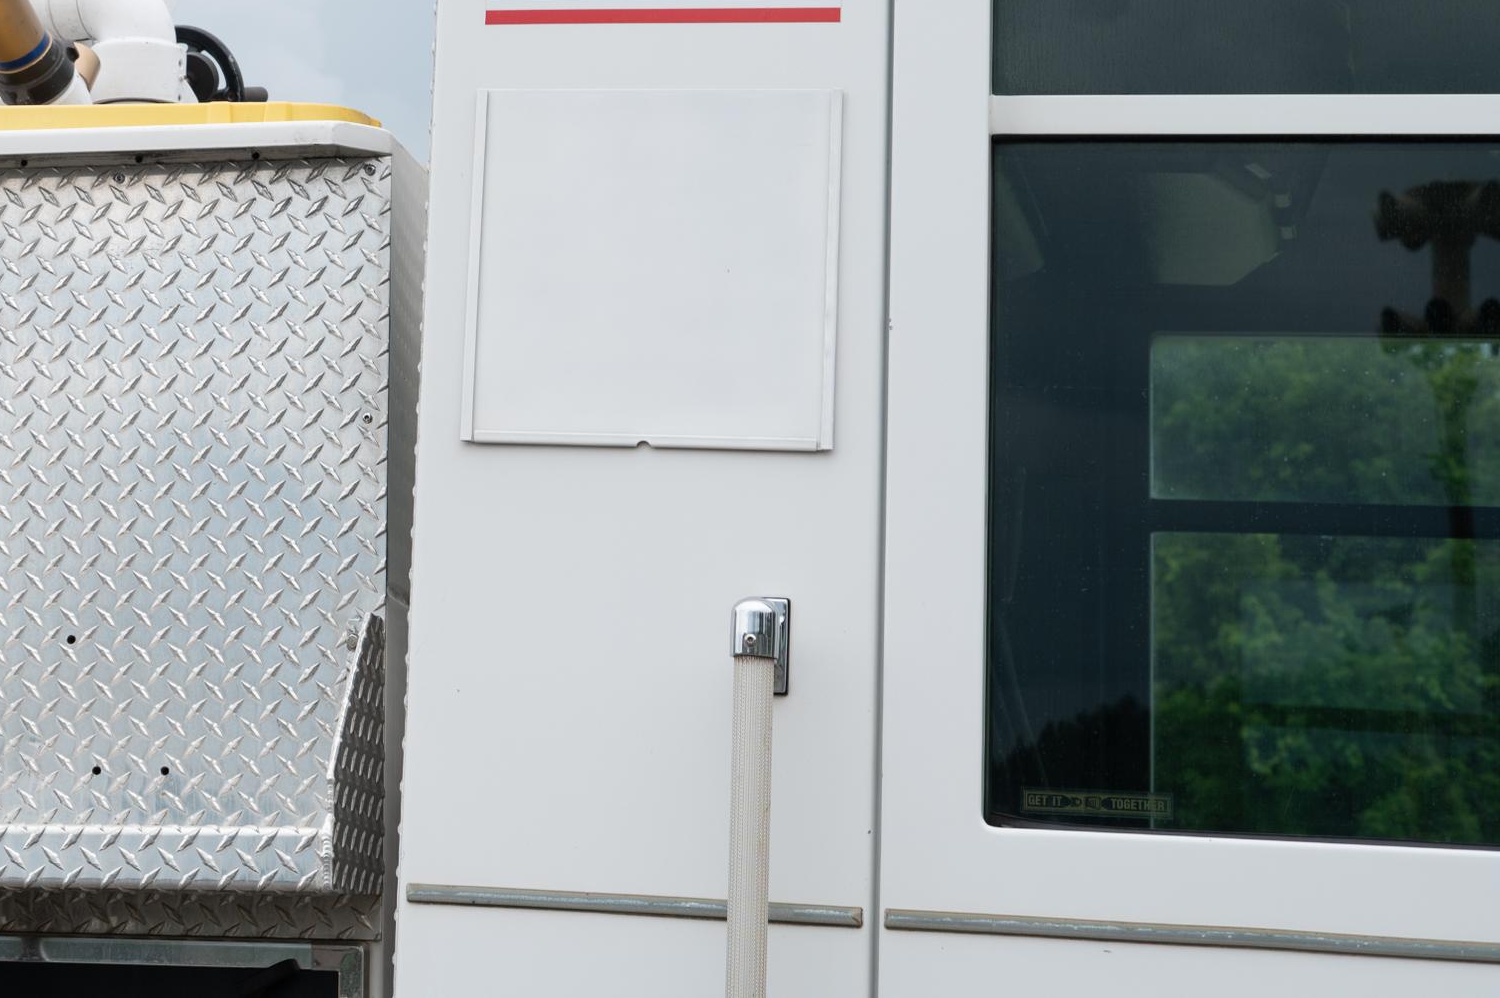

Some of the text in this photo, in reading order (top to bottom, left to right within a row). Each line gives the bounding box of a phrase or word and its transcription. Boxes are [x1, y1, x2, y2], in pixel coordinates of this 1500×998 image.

[1028, 794, 1165, 811] GET IT TOGETHER
